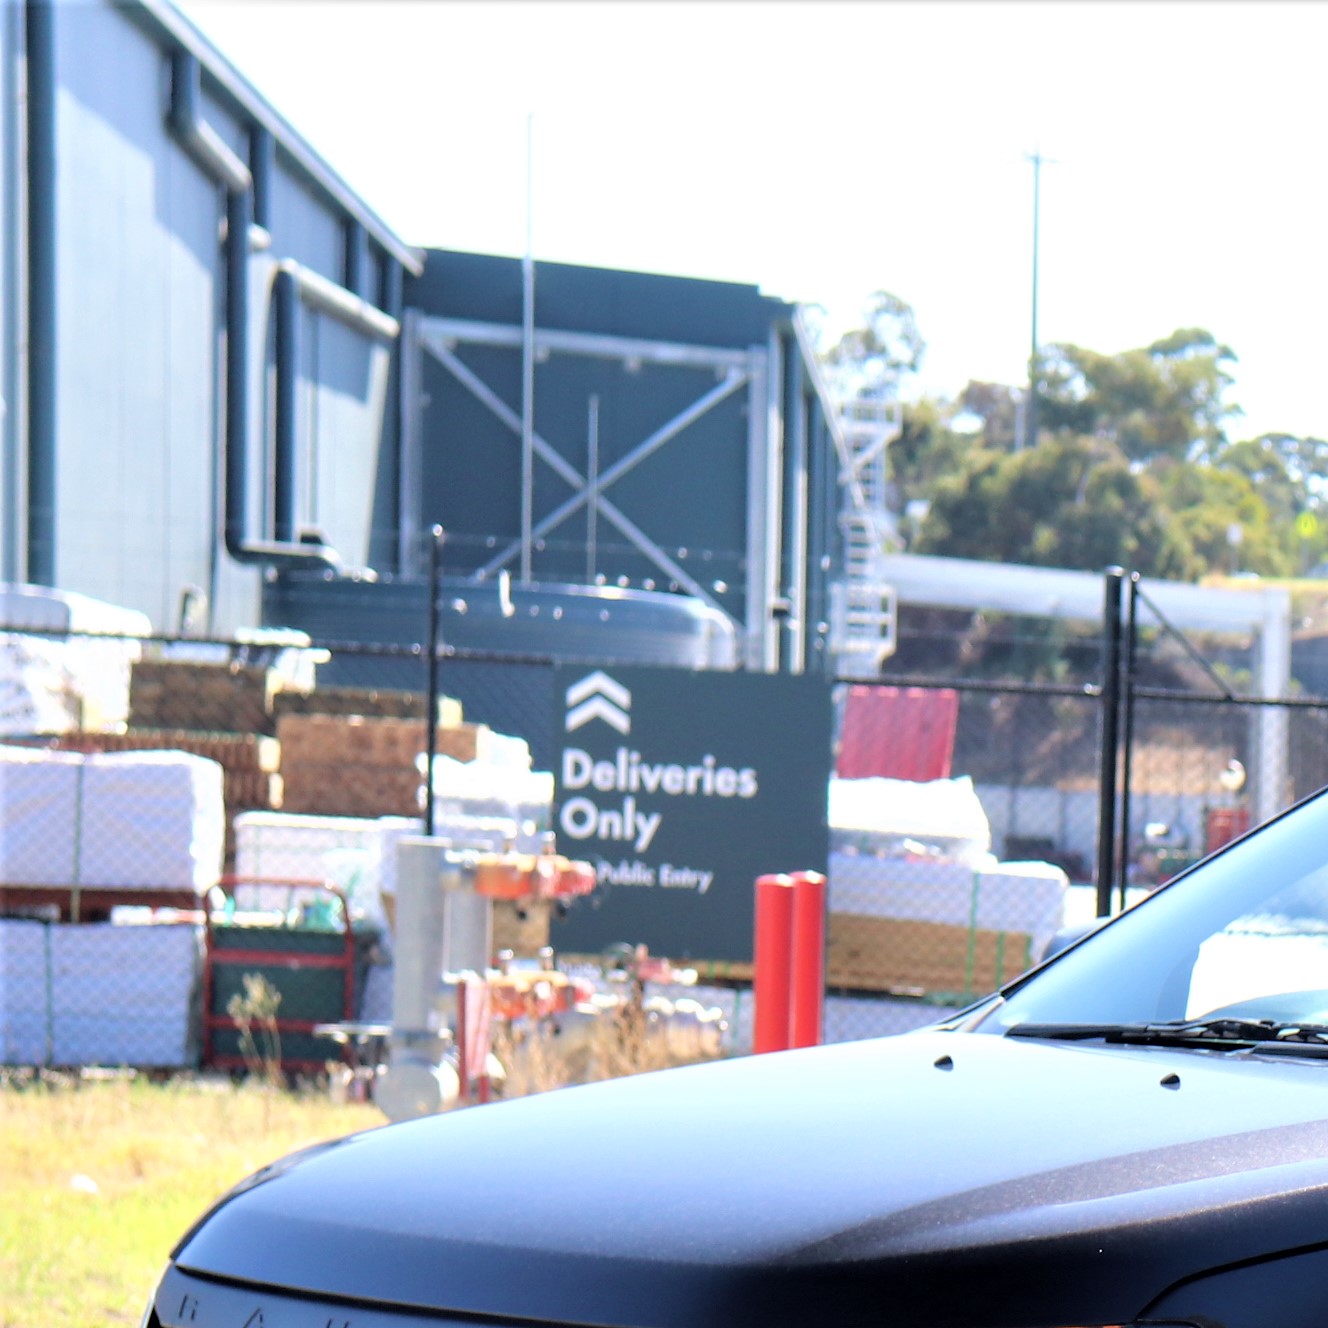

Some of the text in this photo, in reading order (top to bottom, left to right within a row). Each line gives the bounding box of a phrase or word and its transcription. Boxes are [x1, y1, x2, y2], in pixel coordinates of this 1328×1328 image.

[562, 747, 758, 798] Deliveries
[560, 796, 661, 853] Only
[598, 858, 714, 895] Public Entry
